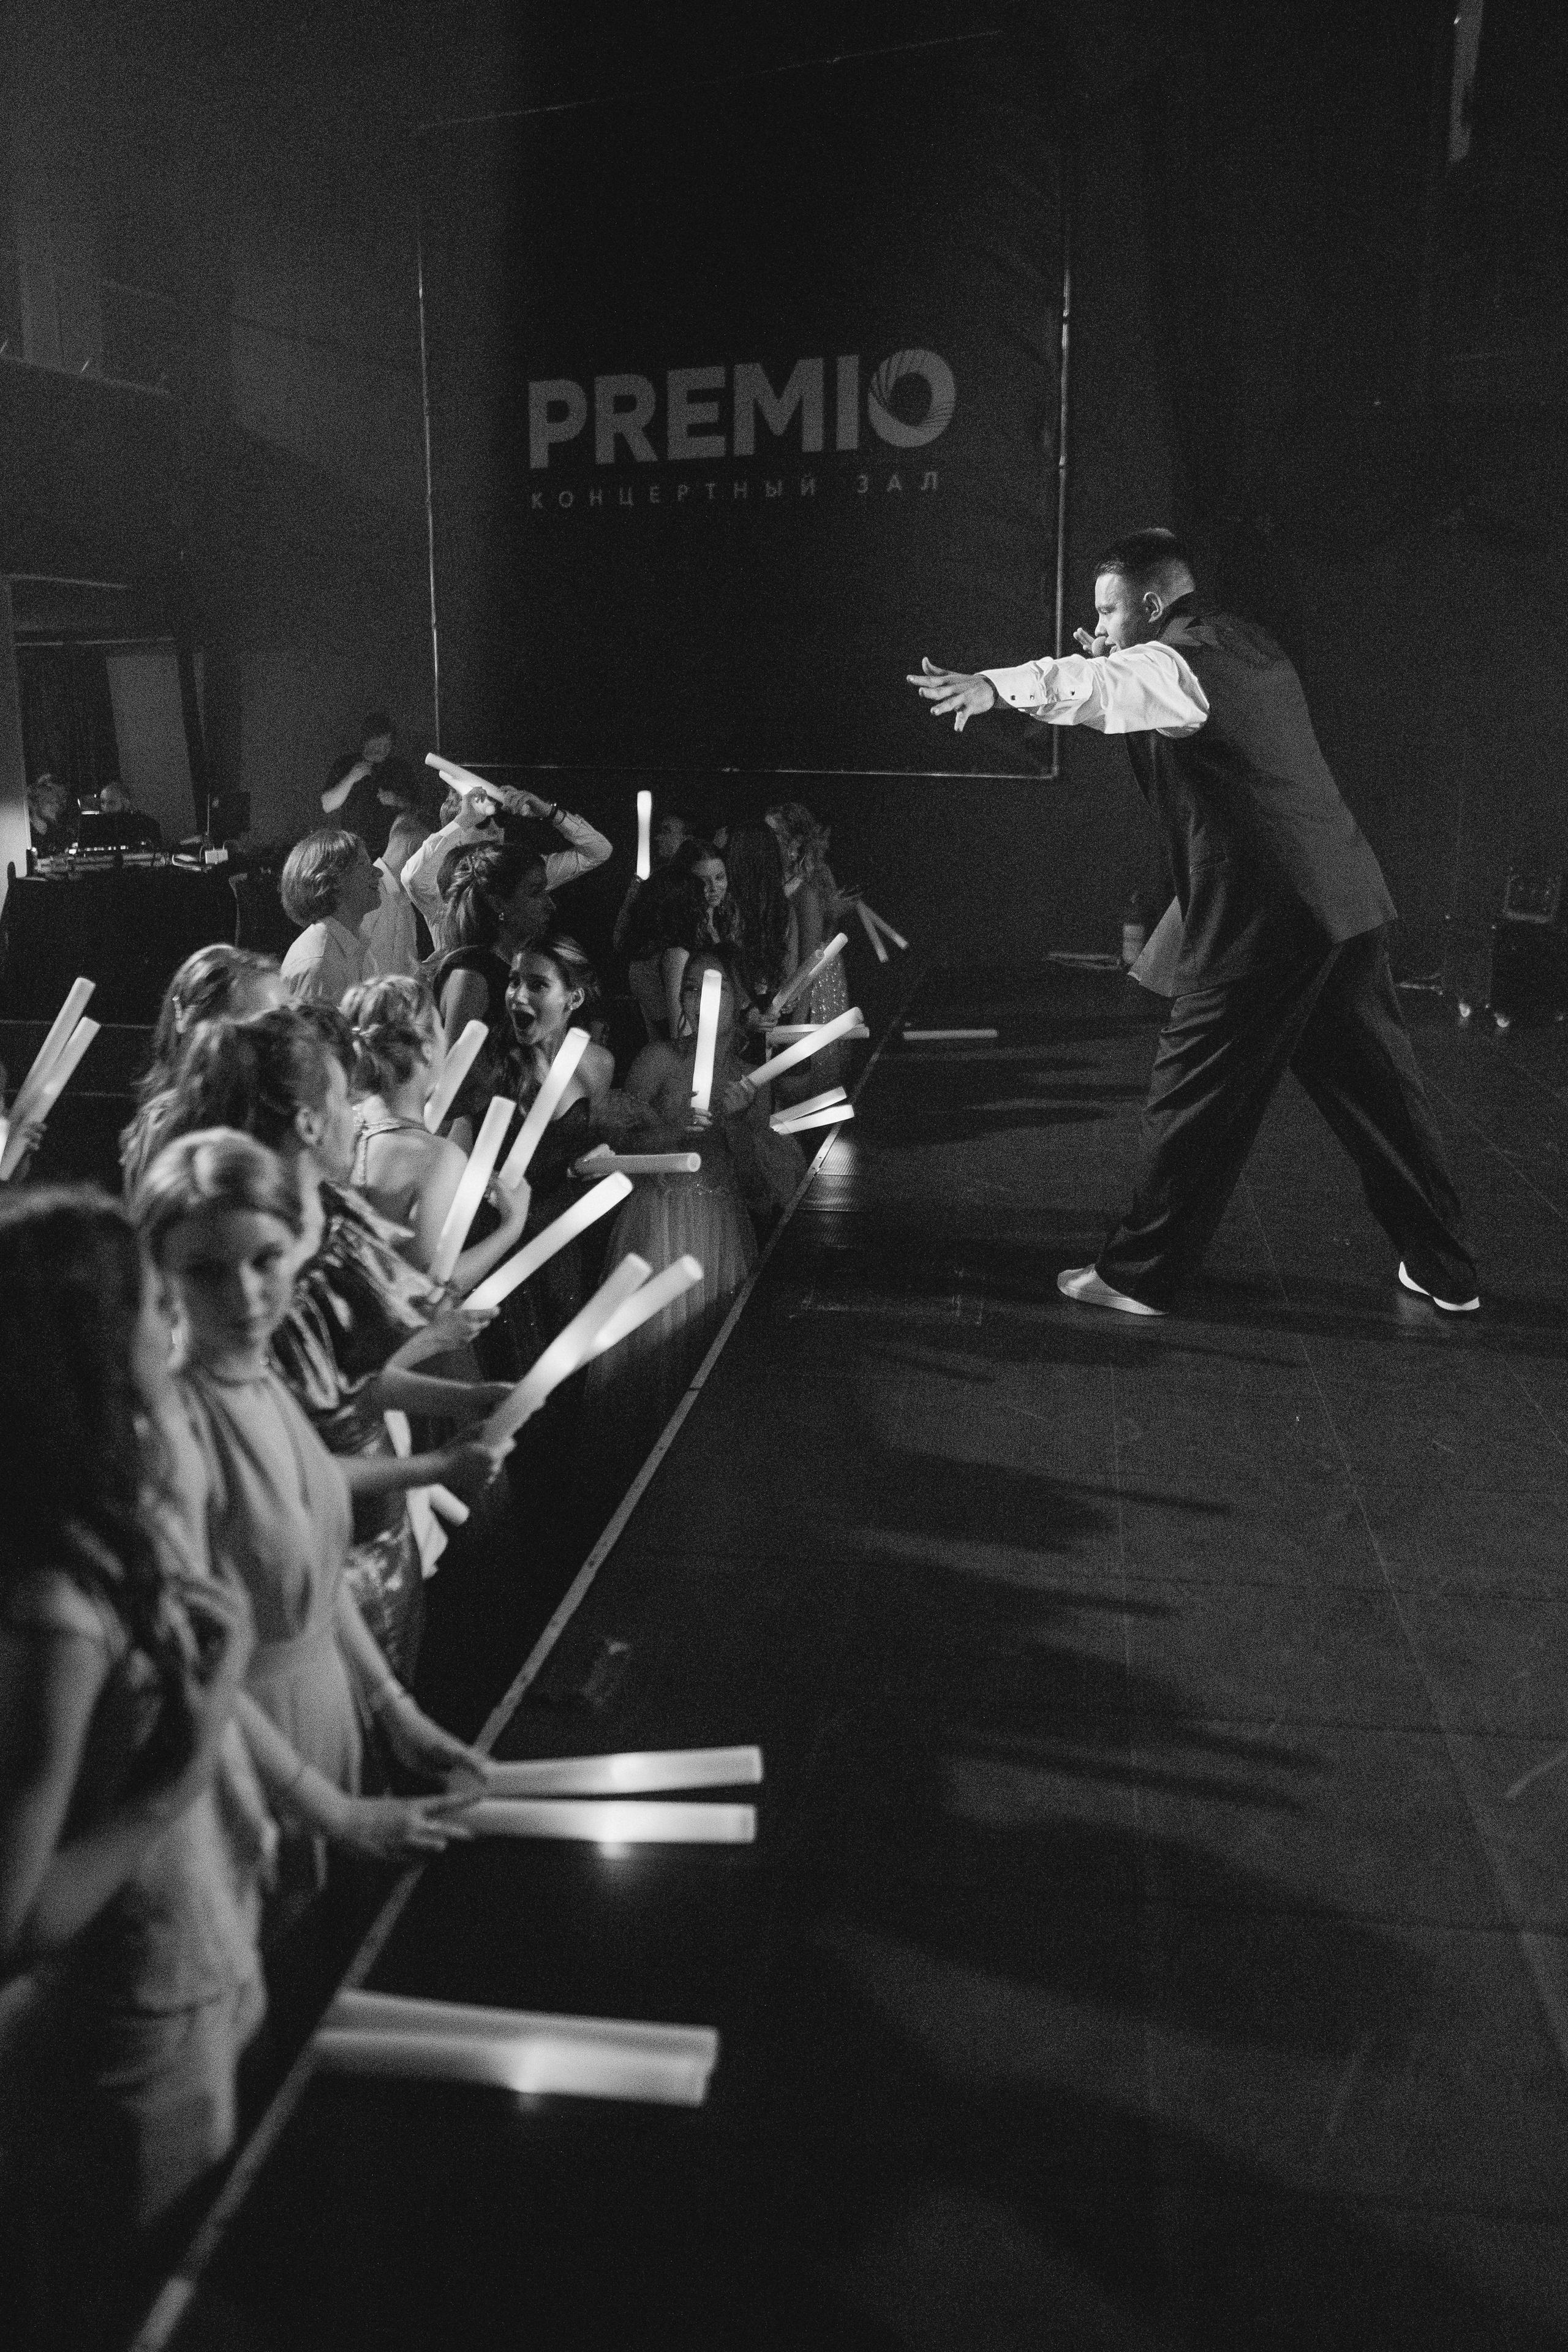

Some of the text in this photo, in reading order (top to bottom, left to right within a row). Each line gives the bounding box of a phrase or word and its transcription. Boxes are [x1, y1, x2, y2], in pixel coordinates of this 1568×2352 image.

[529, 349, 956, 469] PREMIO
[530, 470, 939, 510] КОНЦЕРТНЫЙ ЗАЛ
